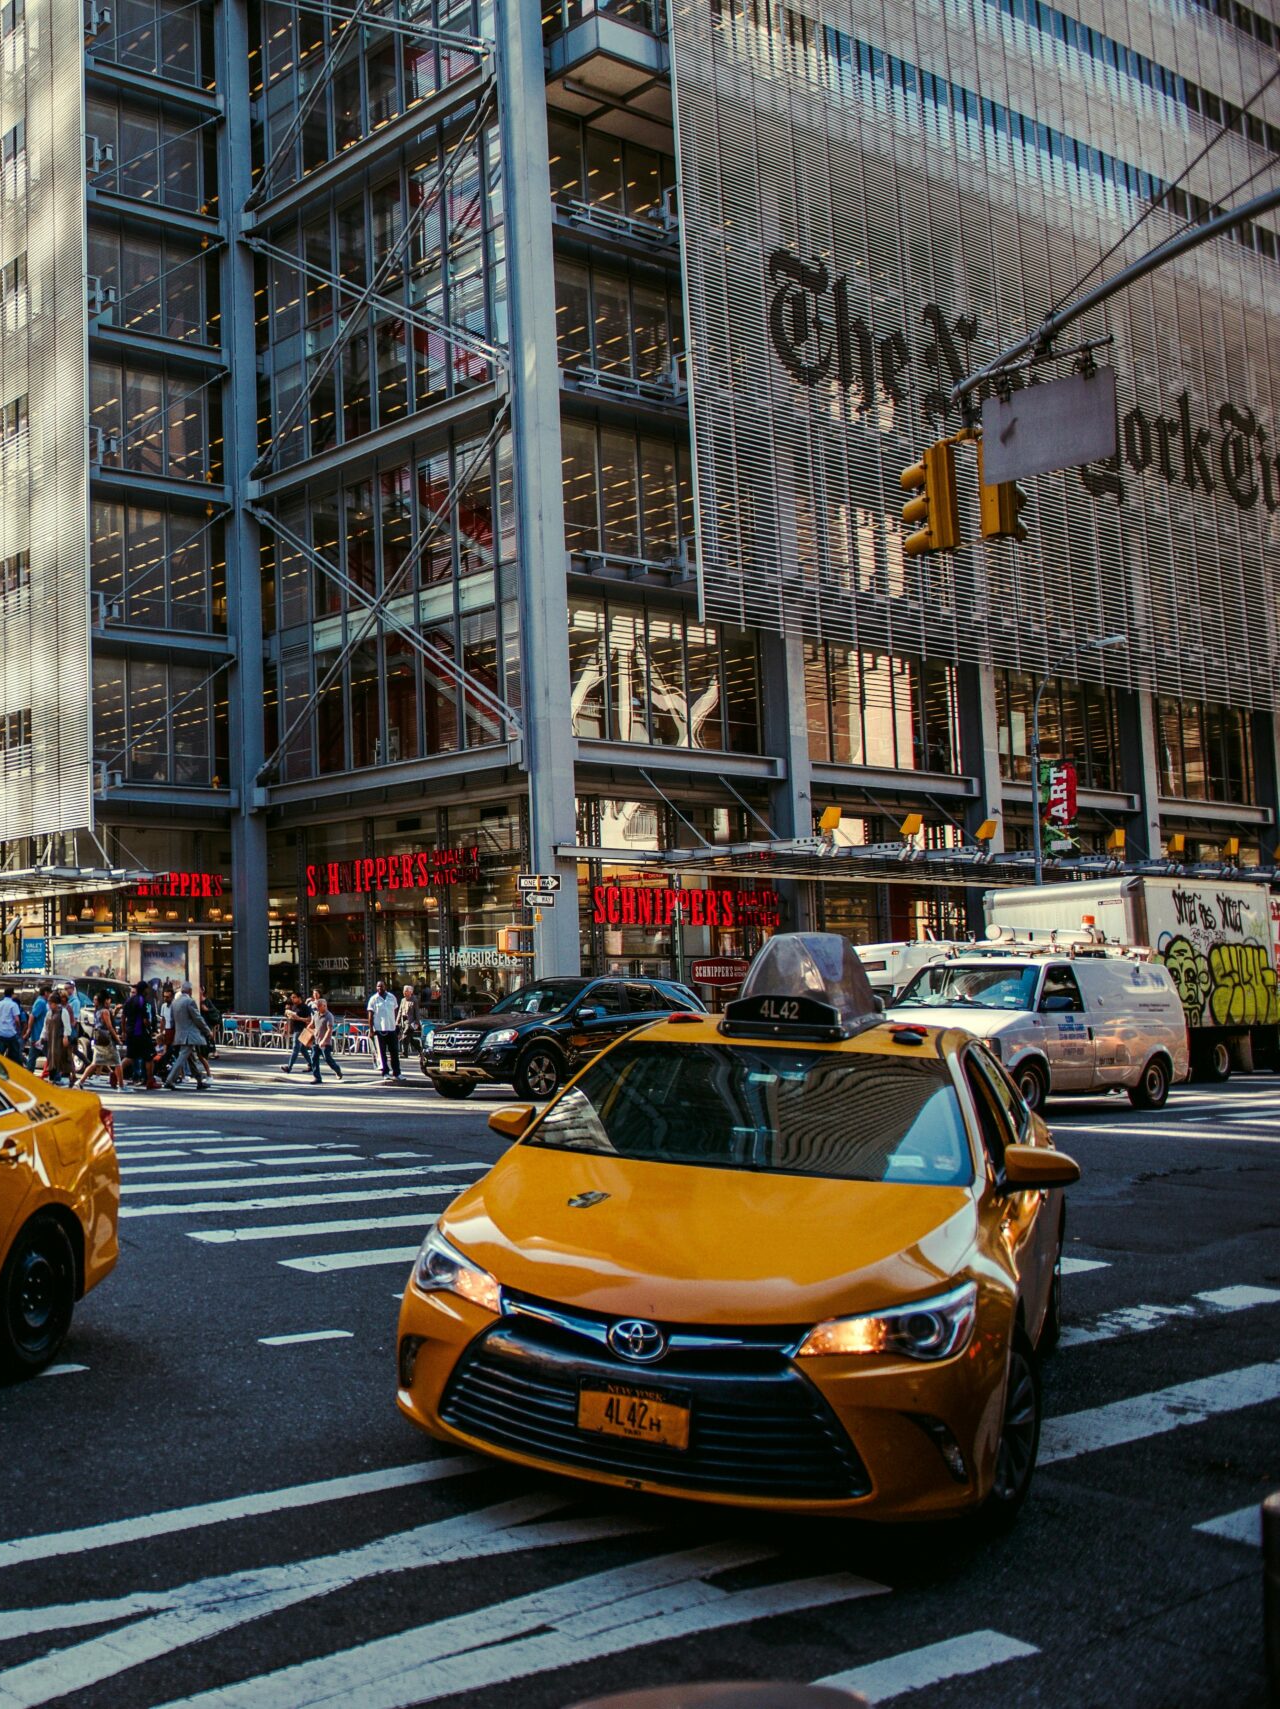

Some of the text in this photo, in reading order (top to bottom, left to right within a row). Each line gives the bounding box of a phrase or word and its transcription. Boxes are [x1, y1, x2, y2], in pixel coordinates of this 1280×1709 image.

[769, 249, 911, 412] The
[1049, 767, 1068, 820] ART
[431, 847, 478, 867] QUALIY
[306, 851, 429, 897] SCHNIPPER'S
[541, 879, 554, 887] WAY
[136, 872, 224, 897] HNIPPER'S
[593, 886, 734, 927] SCHNIPPER'S
[318, 957, 349, 971] SALADS
[695, 965, 734, 978] SCHNIPPER'S
[760, 1000, 800, 1020] 4L42
[607, 1383, 633, 1396] NEW
